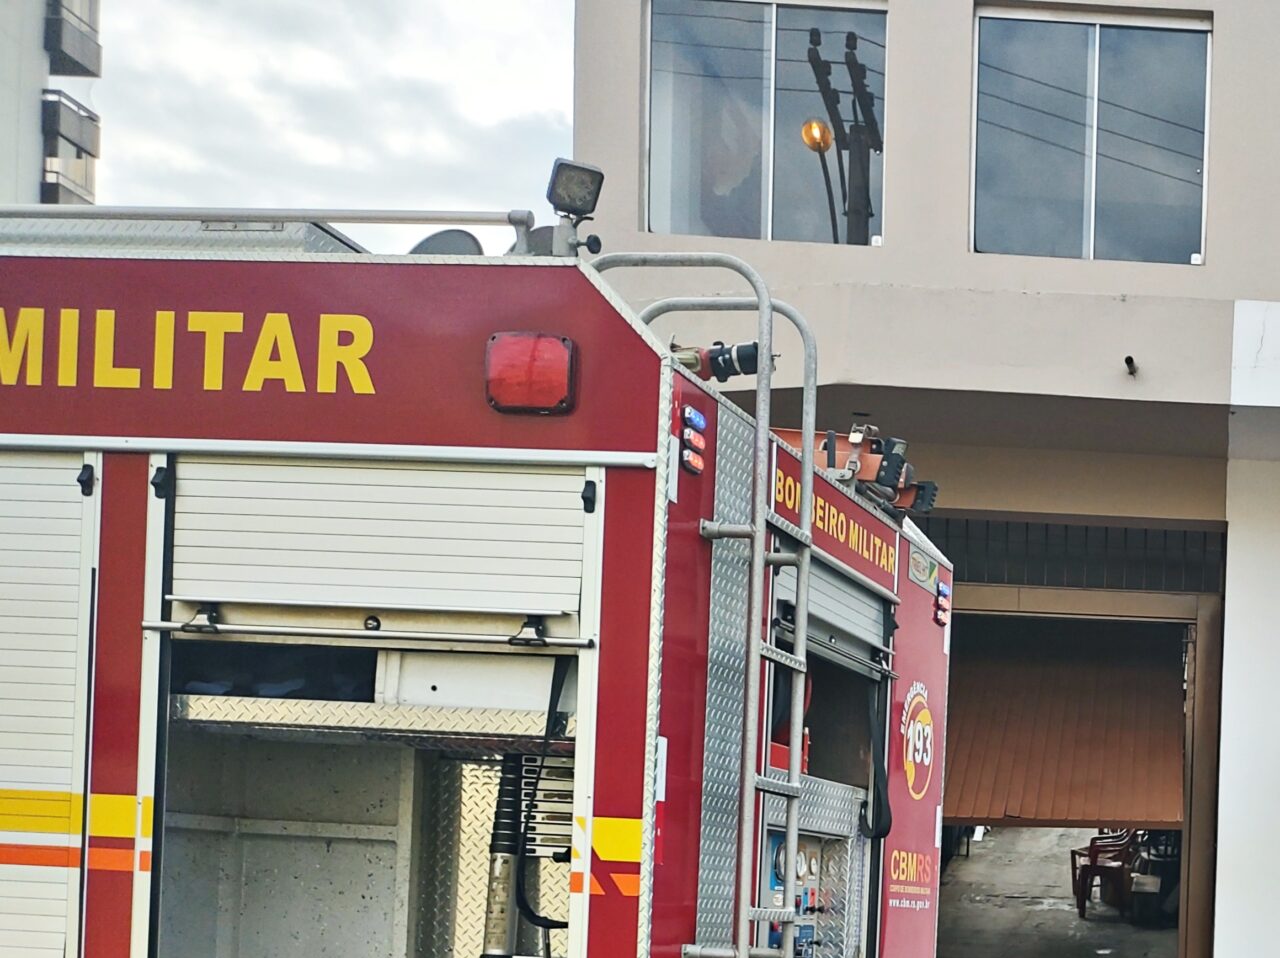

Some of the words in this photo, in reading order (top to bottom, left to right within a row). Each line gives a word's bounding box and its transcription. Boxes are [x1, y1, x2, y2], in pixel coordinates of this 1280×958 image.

[0, 307, 376, 394] MILITAR
[849, 519, 896, 575] MILITAR
[907, 719, 932, 766] 193
[890, 849, 931, 883] CBMRS
